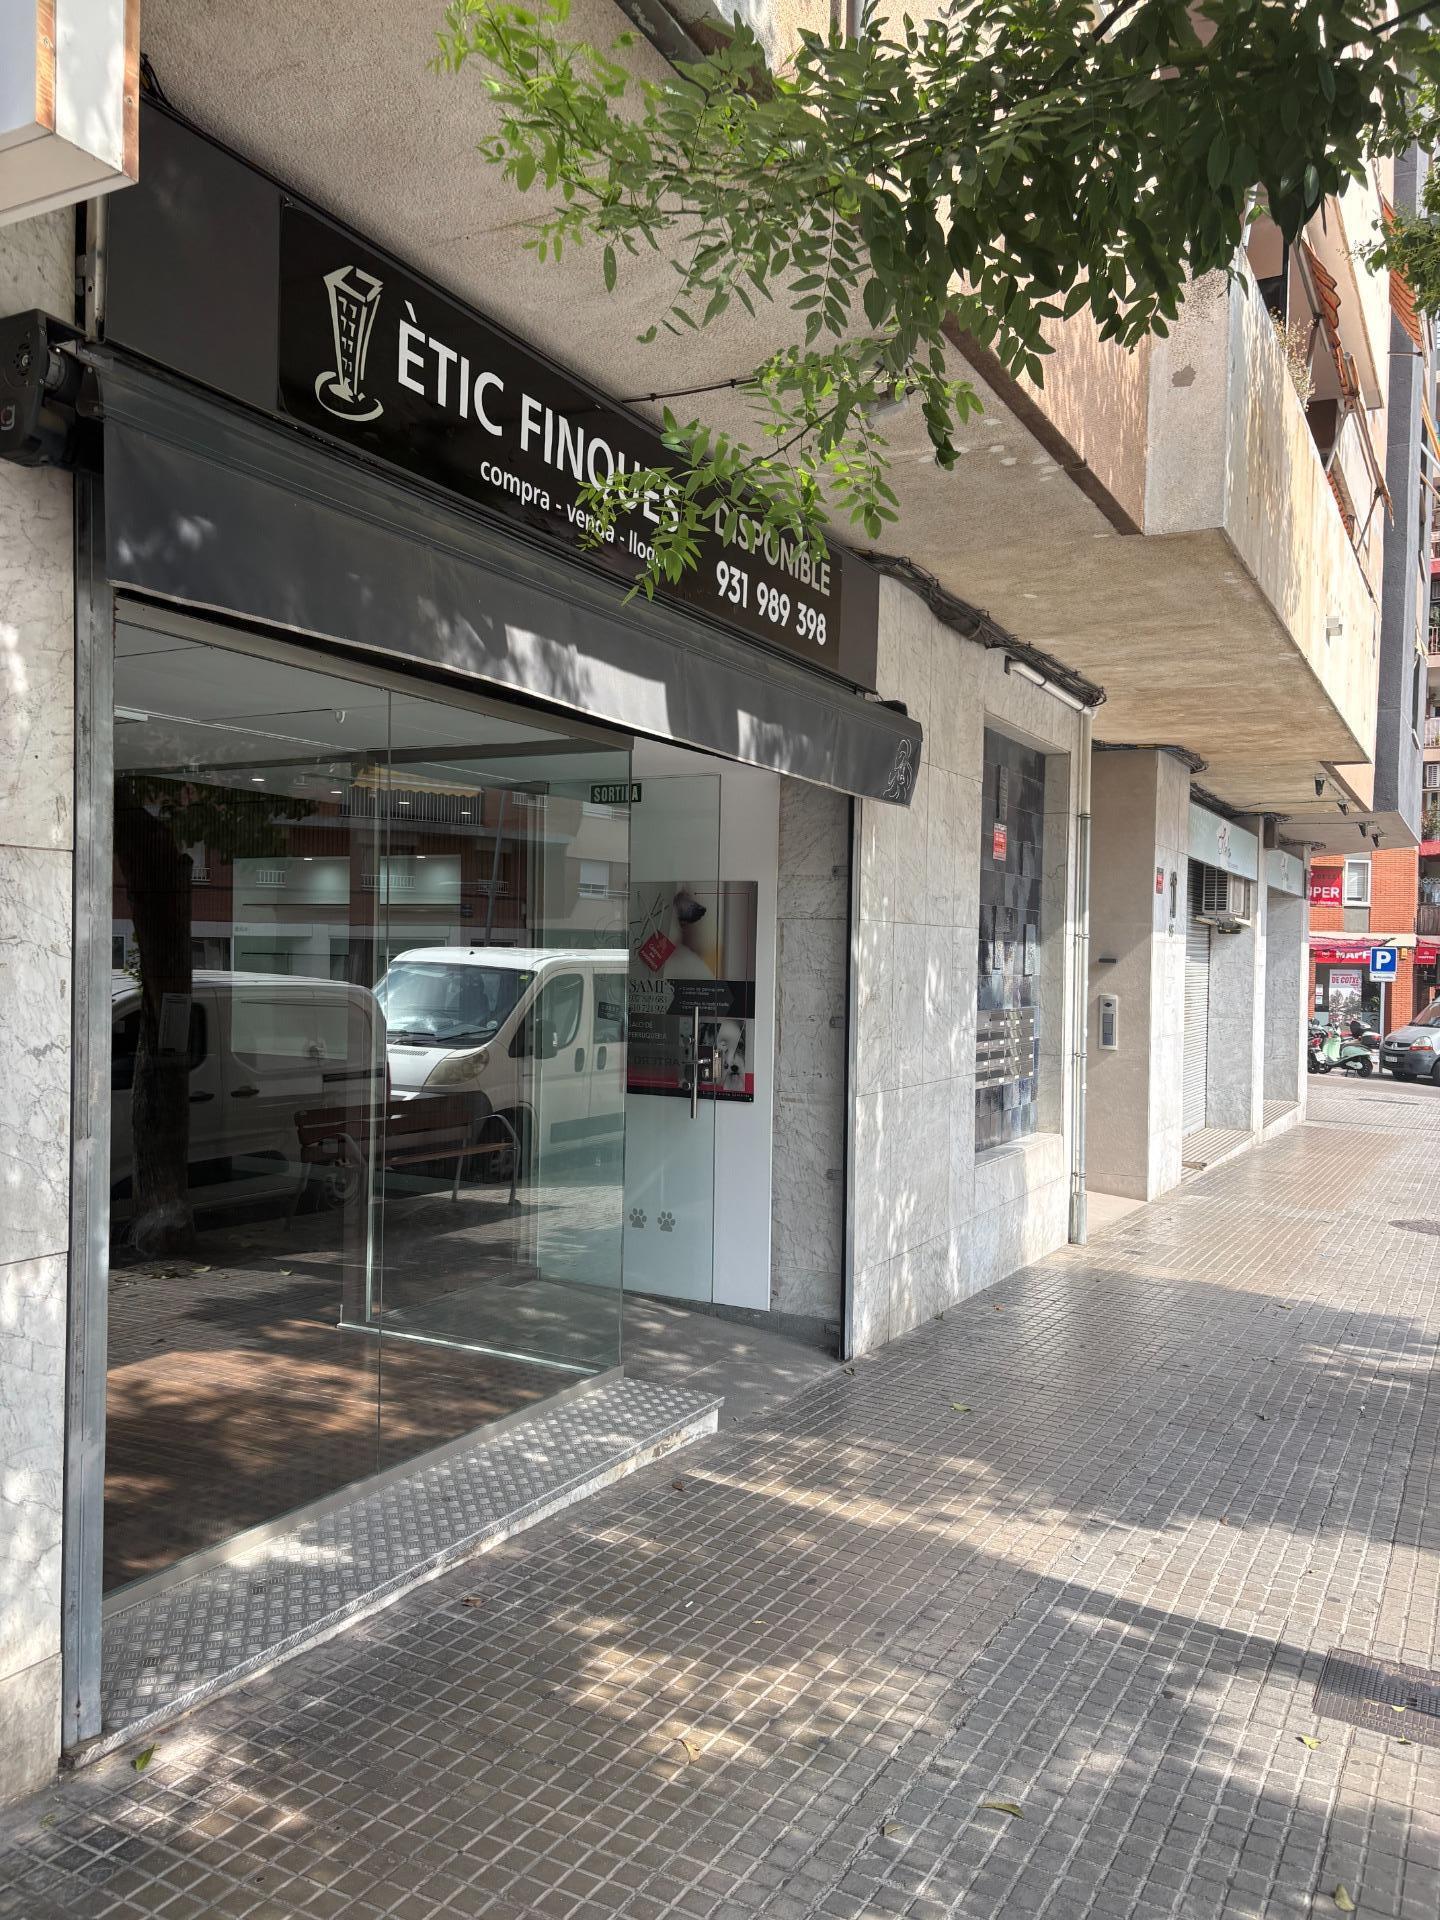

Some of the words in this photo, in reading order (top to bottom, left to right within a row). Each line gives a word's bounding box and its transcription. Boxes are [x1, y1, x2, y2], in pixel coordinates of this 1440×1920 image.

[397, 299, 504, 437] ÈTIC
[519, 392, 680, 532] FINQUES
[480, 458, 551, 513] compra
[715, 502, 831, 597] DISPONIBLE
[715, 560, 749, 609] 931
[756, 581, 791, 628] 989
[795, 601, 827, 647] 398
[1375, 950, 1392, 970] P
